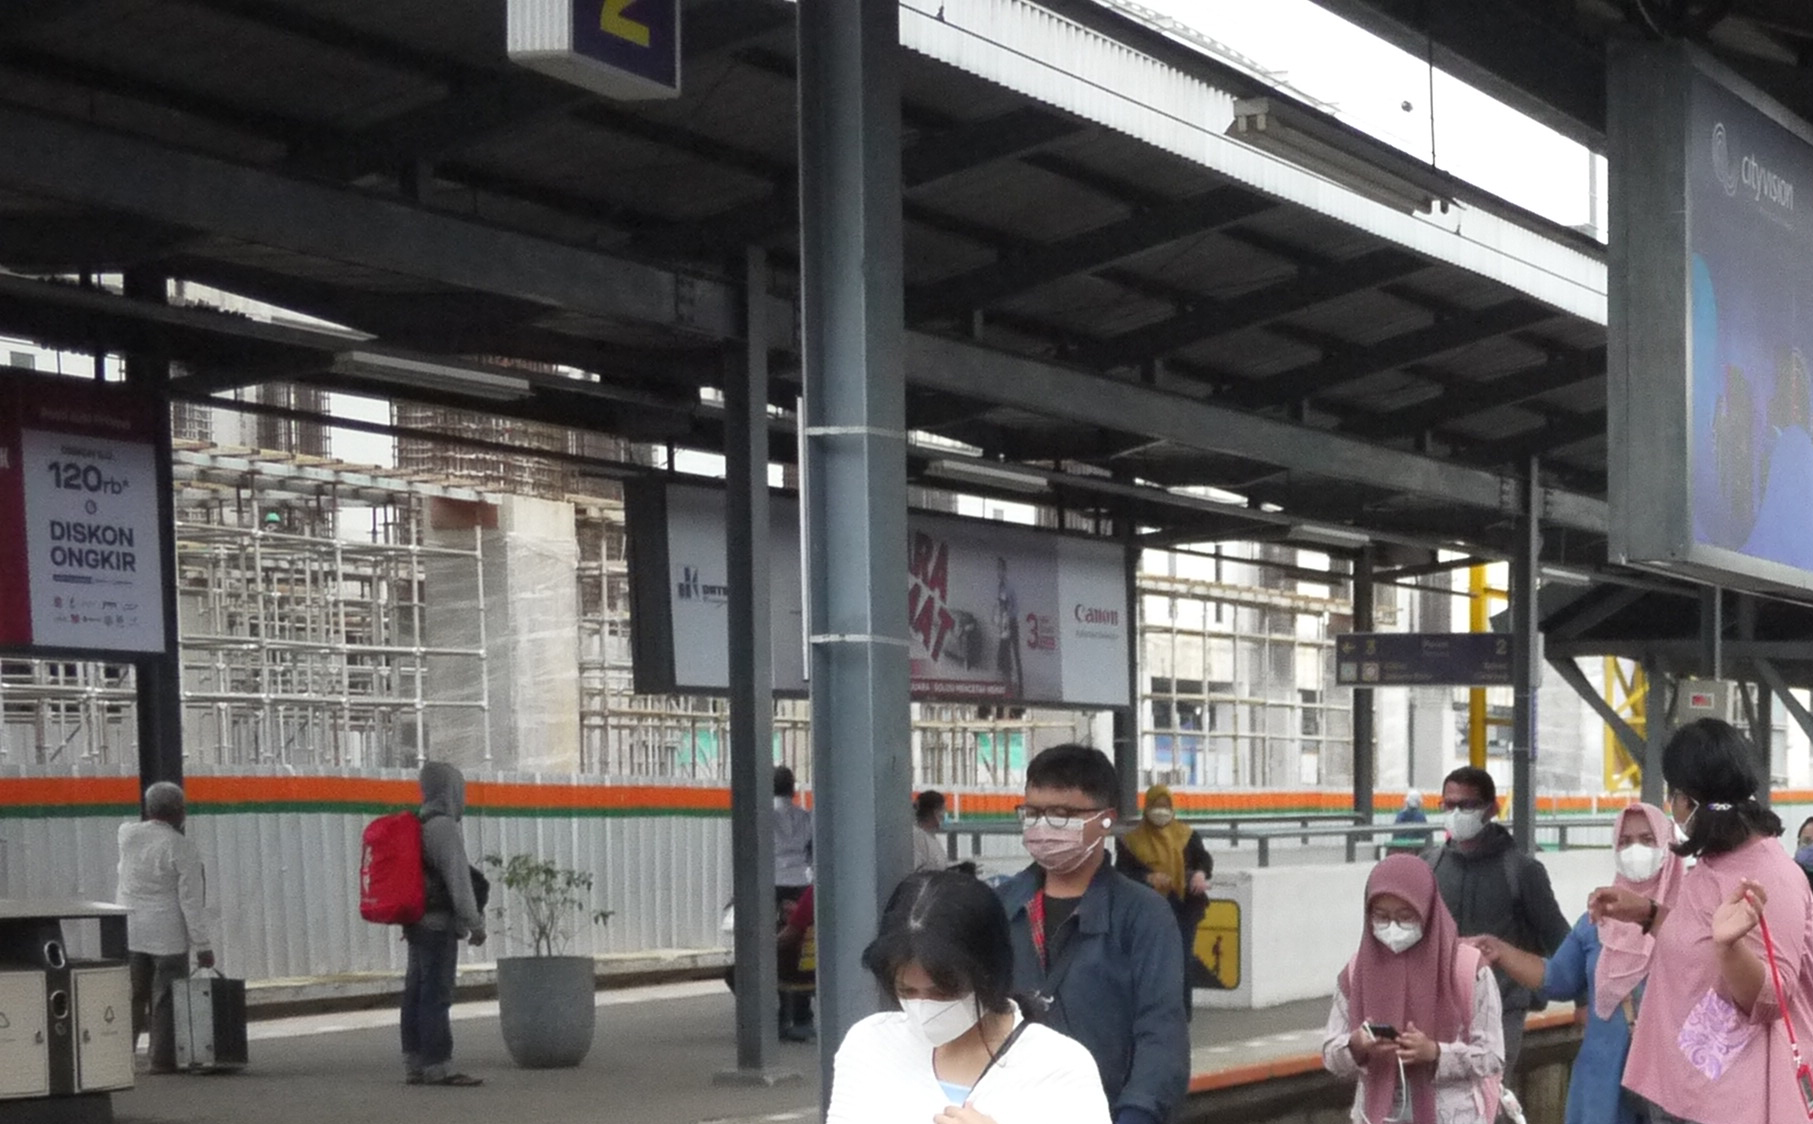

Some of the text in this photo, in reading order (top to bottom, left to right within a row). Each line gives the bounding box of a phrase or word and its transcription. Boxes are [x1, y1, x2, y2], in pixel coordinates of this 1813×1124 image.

[1742, 153, 1794, 210] cityvision
[49, 519, 135, 548] DISKON
[50, 545, 137, 573] ONGKIR
[1074, 604, 1119, 626] Canon
